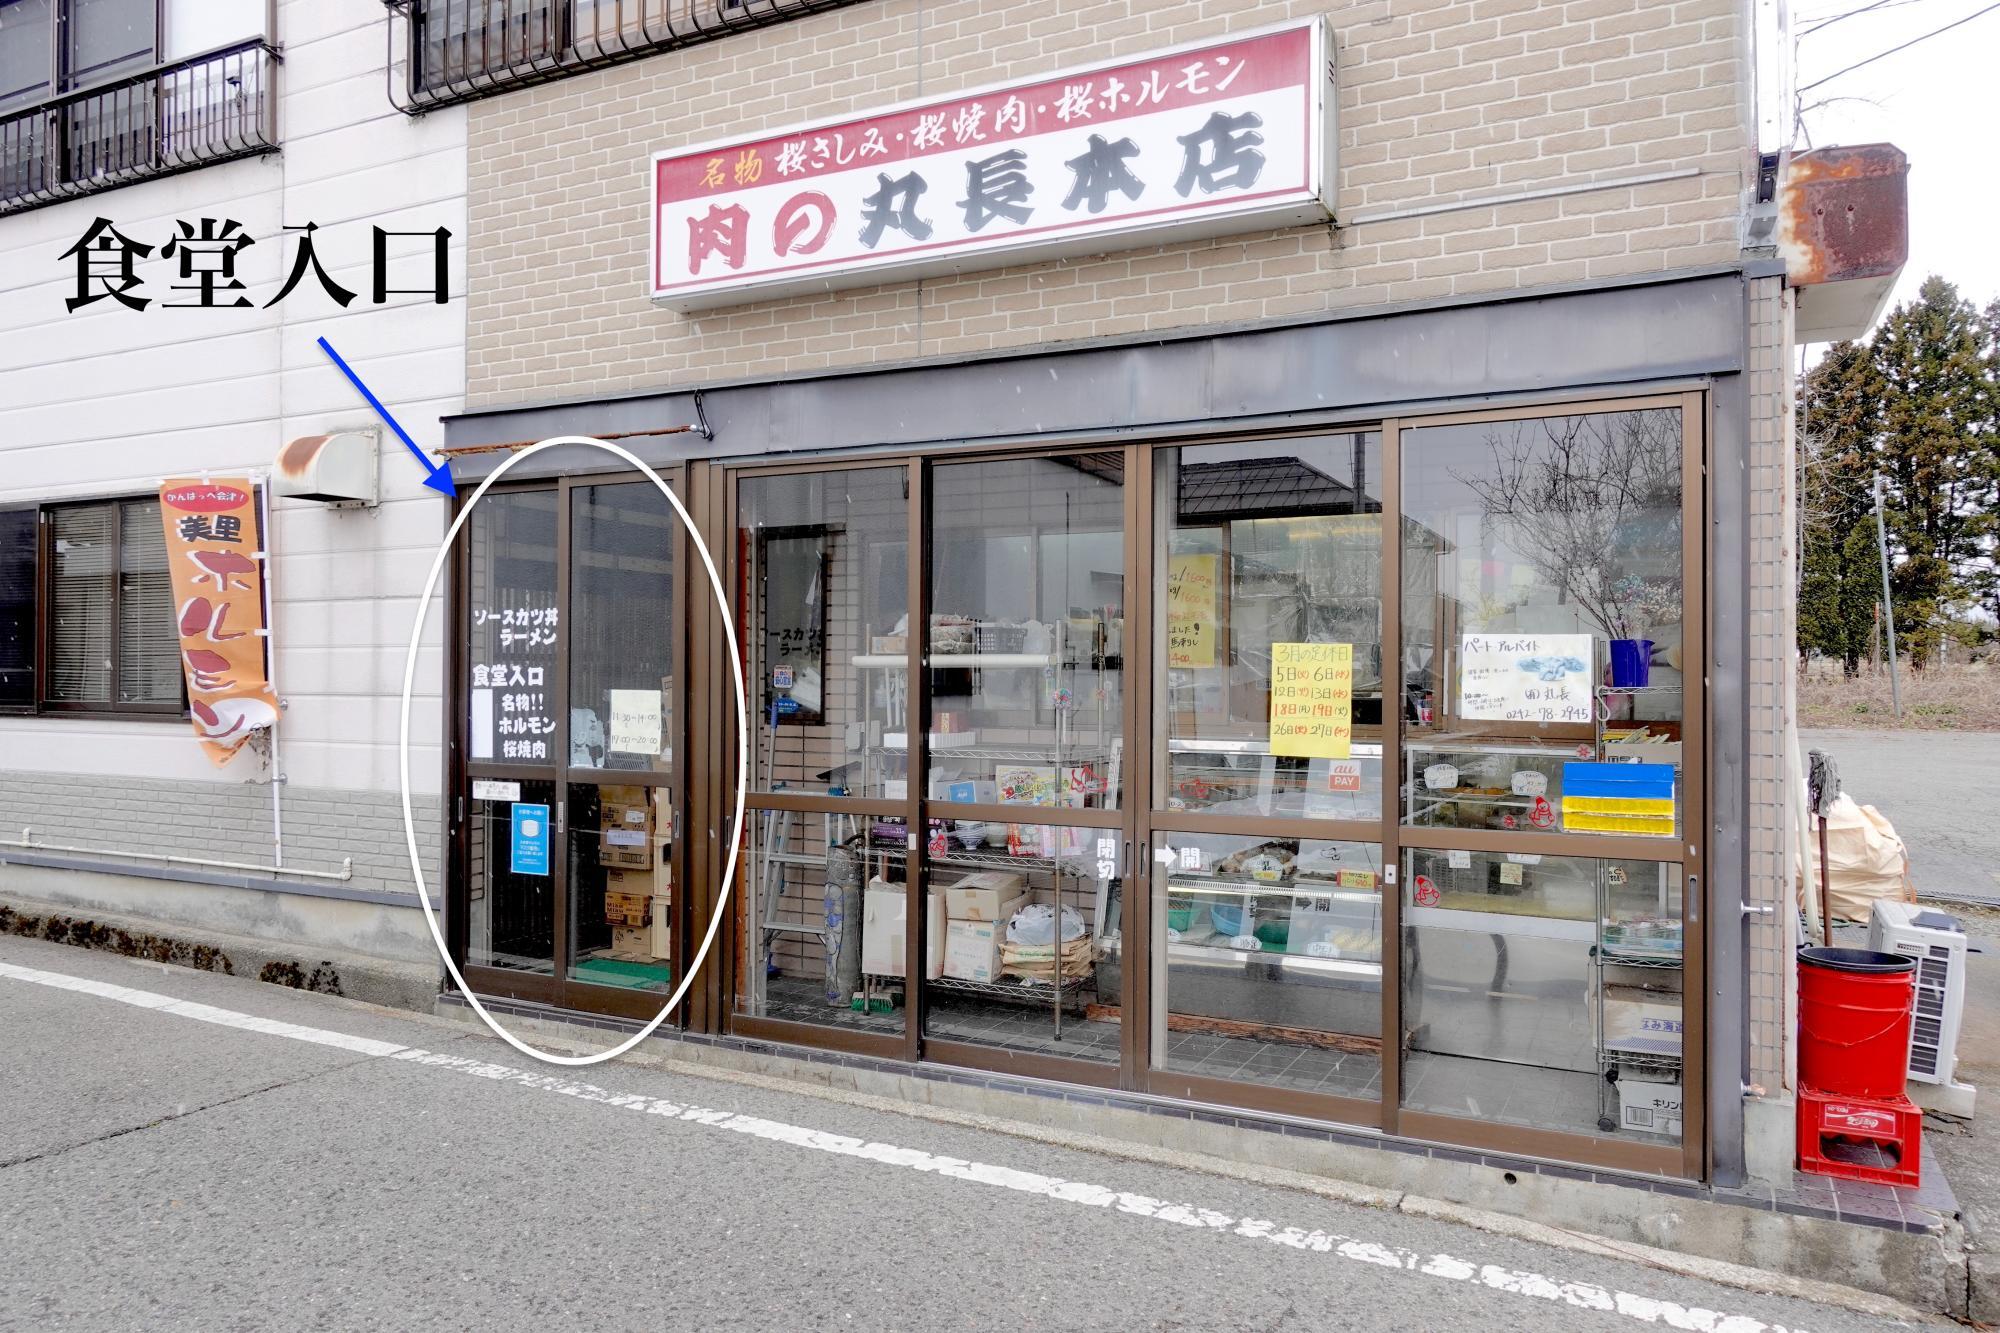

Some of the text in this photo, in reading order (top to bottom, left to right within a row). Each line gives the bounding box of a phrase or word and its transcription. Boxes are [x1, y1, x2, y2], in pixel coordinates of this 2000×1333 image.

[698, 154, 763, 190] 名物
[687, 111, 1267, 275] 肉の丸長本店
[176, 514, 243, 543] 美里
[474, 608, 559, 626] ソースカツ丼
[500, 628, 557, 646] ラーメン
[473, 663, 544, 687] 食堂入口
[502, 693, 544, 711] 名物!!
[498, 717, 556, 735] ホルモン
[503, 740, 546, 759] 桜焼肉
[1334, 764, 1357, 774] au
[1334, 776, 1354, 786] PAY
[1096, 838, 1116, 880] 閉切
[1181, 847, 1200, 868] 開
[1652, 1098, 1682, 1110] キリン
